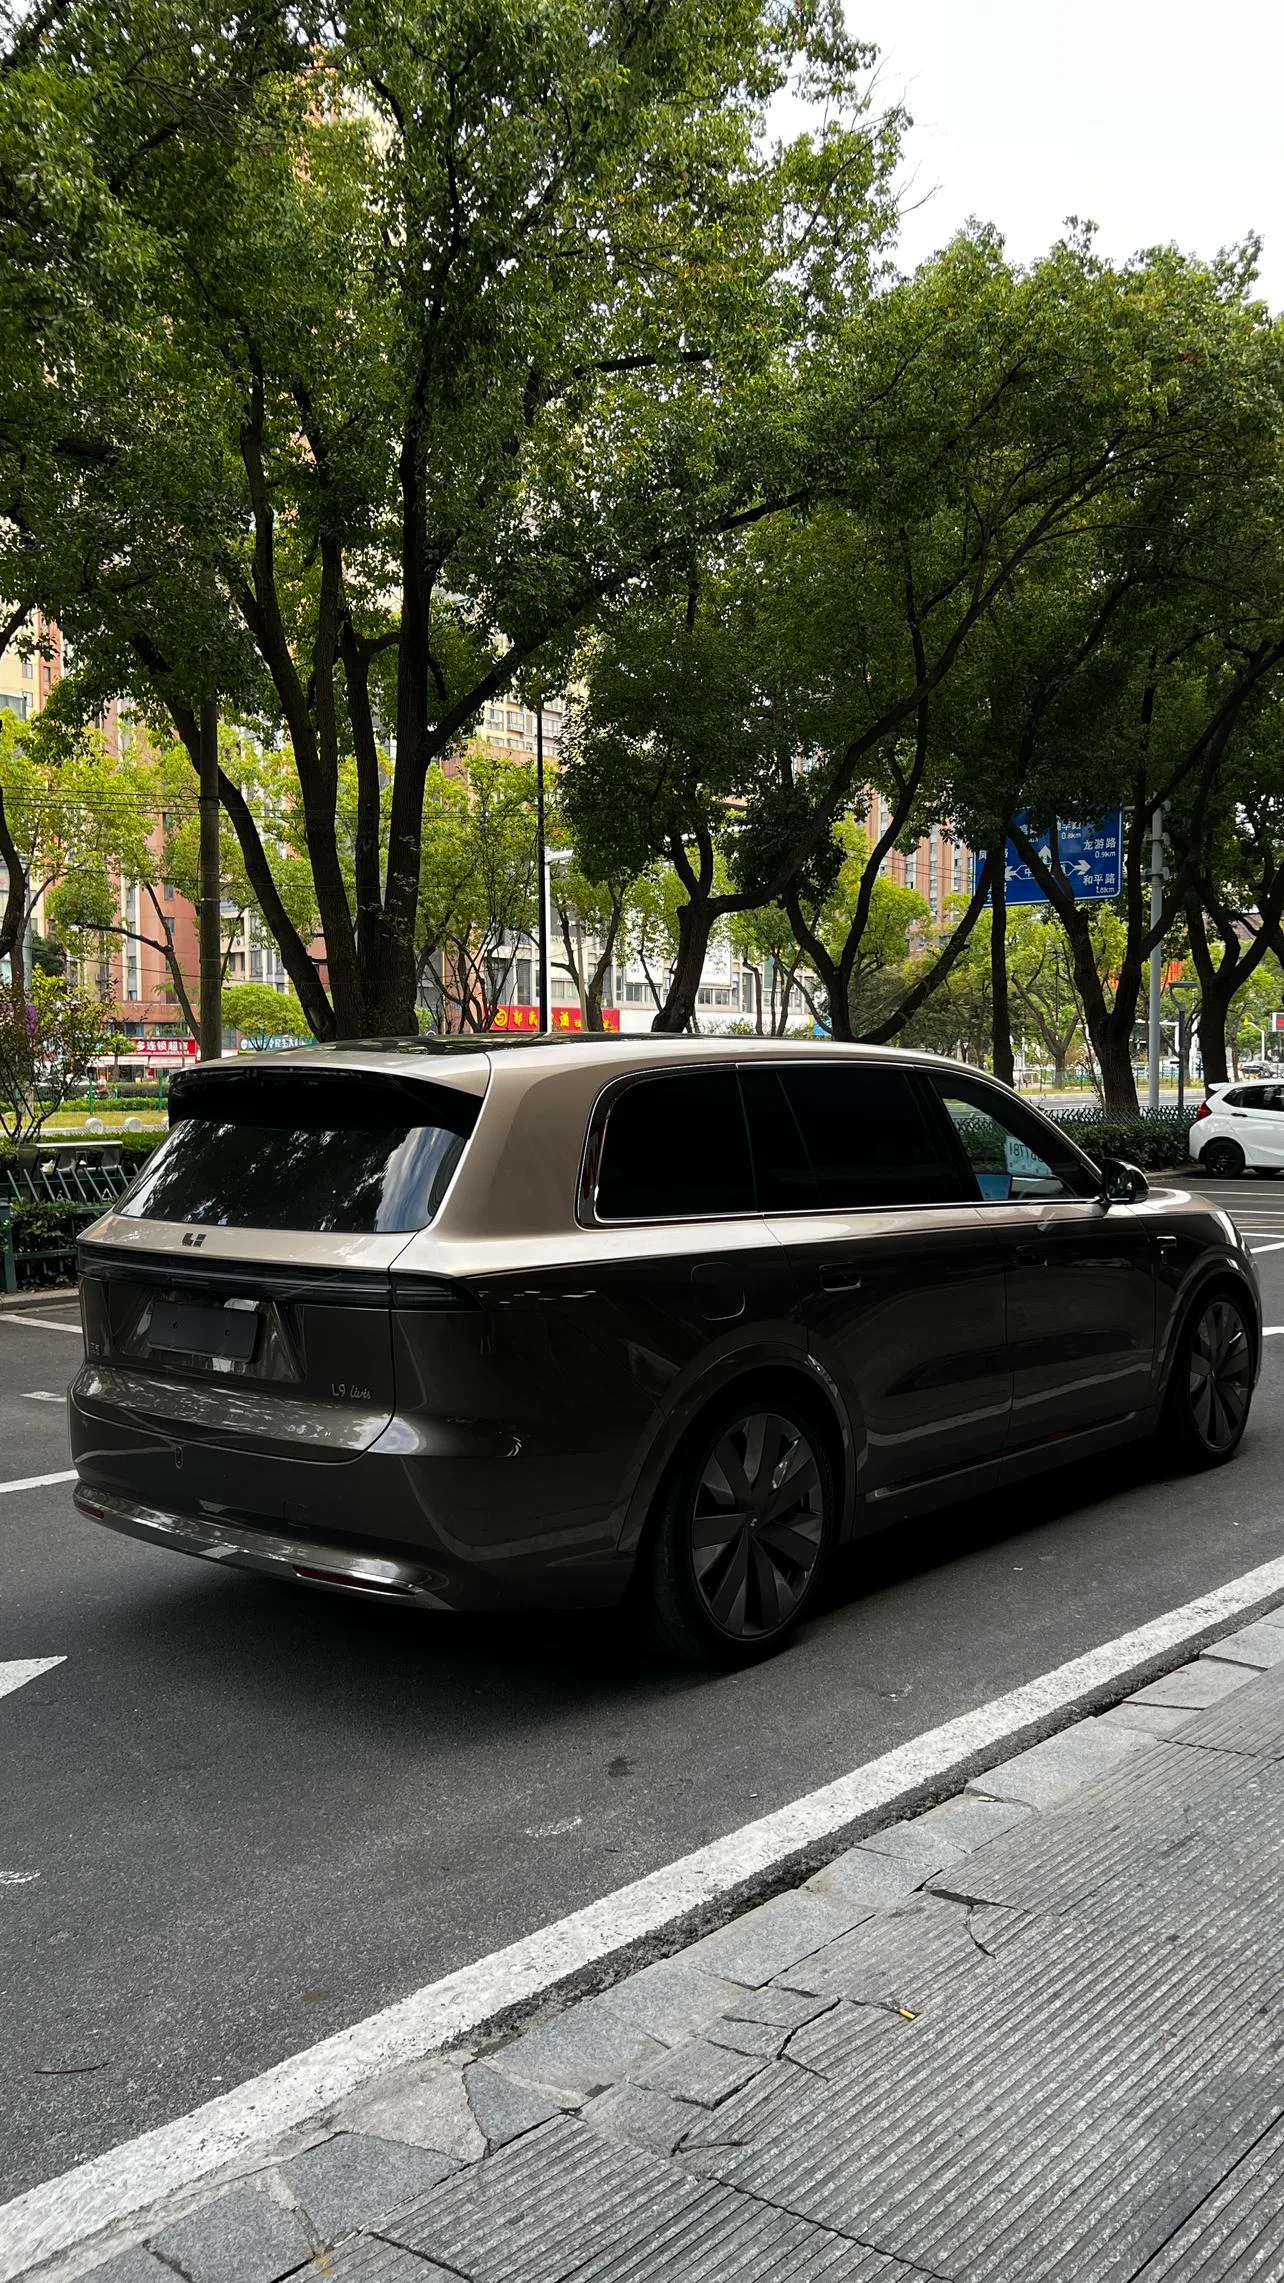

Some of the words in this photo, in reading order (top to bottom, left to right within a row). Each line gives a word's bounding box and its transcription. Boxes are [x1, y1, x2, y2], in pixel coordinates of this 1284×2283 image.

[1083, 837, 1117, 851] 龙游路
[1082, 872, 1116, 887] 和平路
[331, 1383, 346, 1397] L9
